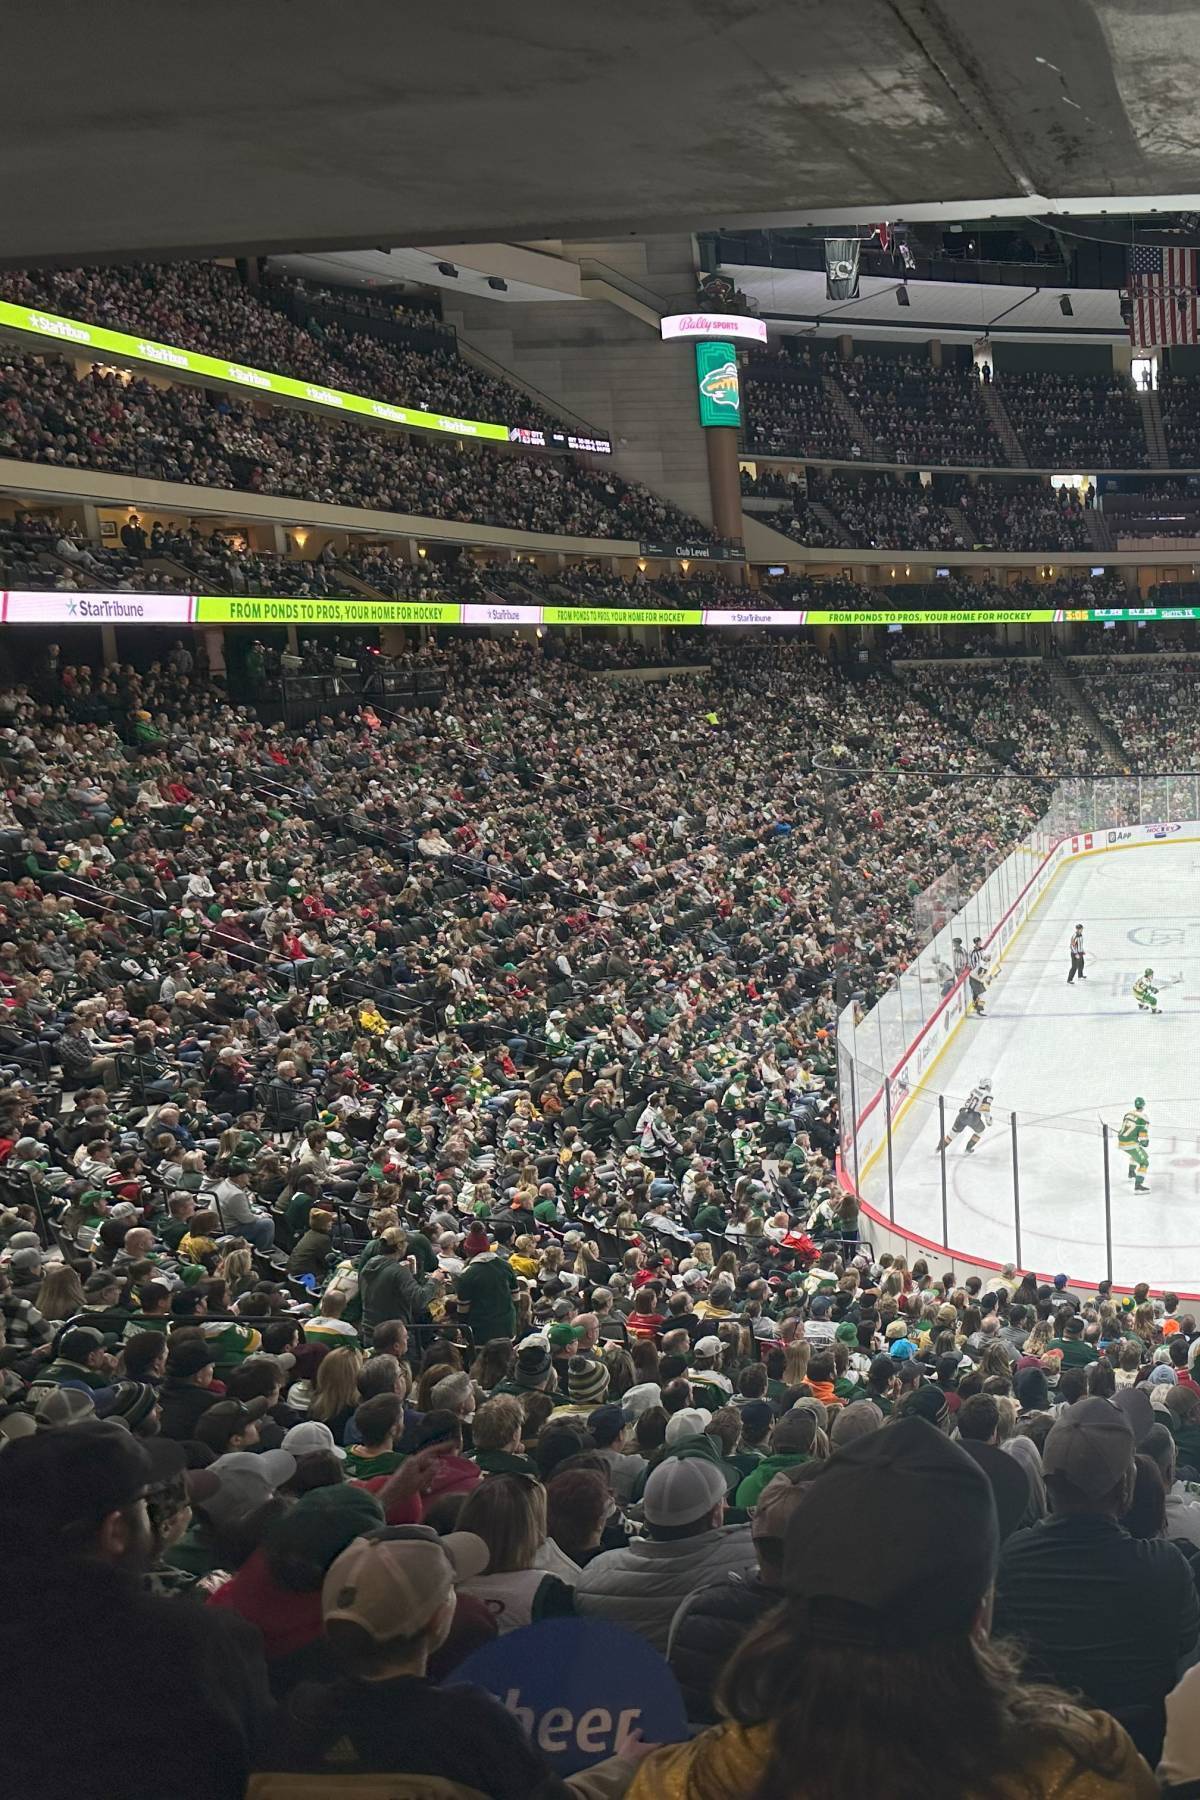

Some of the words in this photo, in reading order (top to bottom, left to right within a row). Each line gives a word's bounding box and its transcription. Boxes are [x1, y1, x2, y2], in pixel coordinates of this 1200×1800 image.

[680, 316, 712, 331] Bally
[713, 321, 738, 330] SPORTS
[676, 547, 690, 556] Club
[691, 547, 710, 557] Level
[79, 600, 144, 617] StarTribune
[230, 603, 262, 618] FROM
[264, 604, 298, 619] PONDS
[301, 604, 314, 618] TO
[316, 605, 343, 621] PROS,
[344, 607, 369, 619] YOUR
[371, 607, 396, 619] HOME
[397, 607, 412, 619] FOR
[413, 608, 443, 620] HOCKEY
[492, 609, 520, 621] StarTribune
[611, 612, 627, 622] YOUR
[628, 612, 645, 622] HOME
[645, 612, 657, 622] FOR
[658, 611, 685, 622] HOCKEY
[736, 613, 772, 623] StarTribune
[829, 613, 852, 622] FROM
[854, 613, 883, 622] PONDS
[885, 613, 896, 622] TO
[925, 613, 948, 621] YOUR
[951, 613, 976, 621] HOME
[978, 612, 995, 621] FOR
[997, 612, 1032, 621] HOCKEY
[504, 1688, 642, 1753] heer
